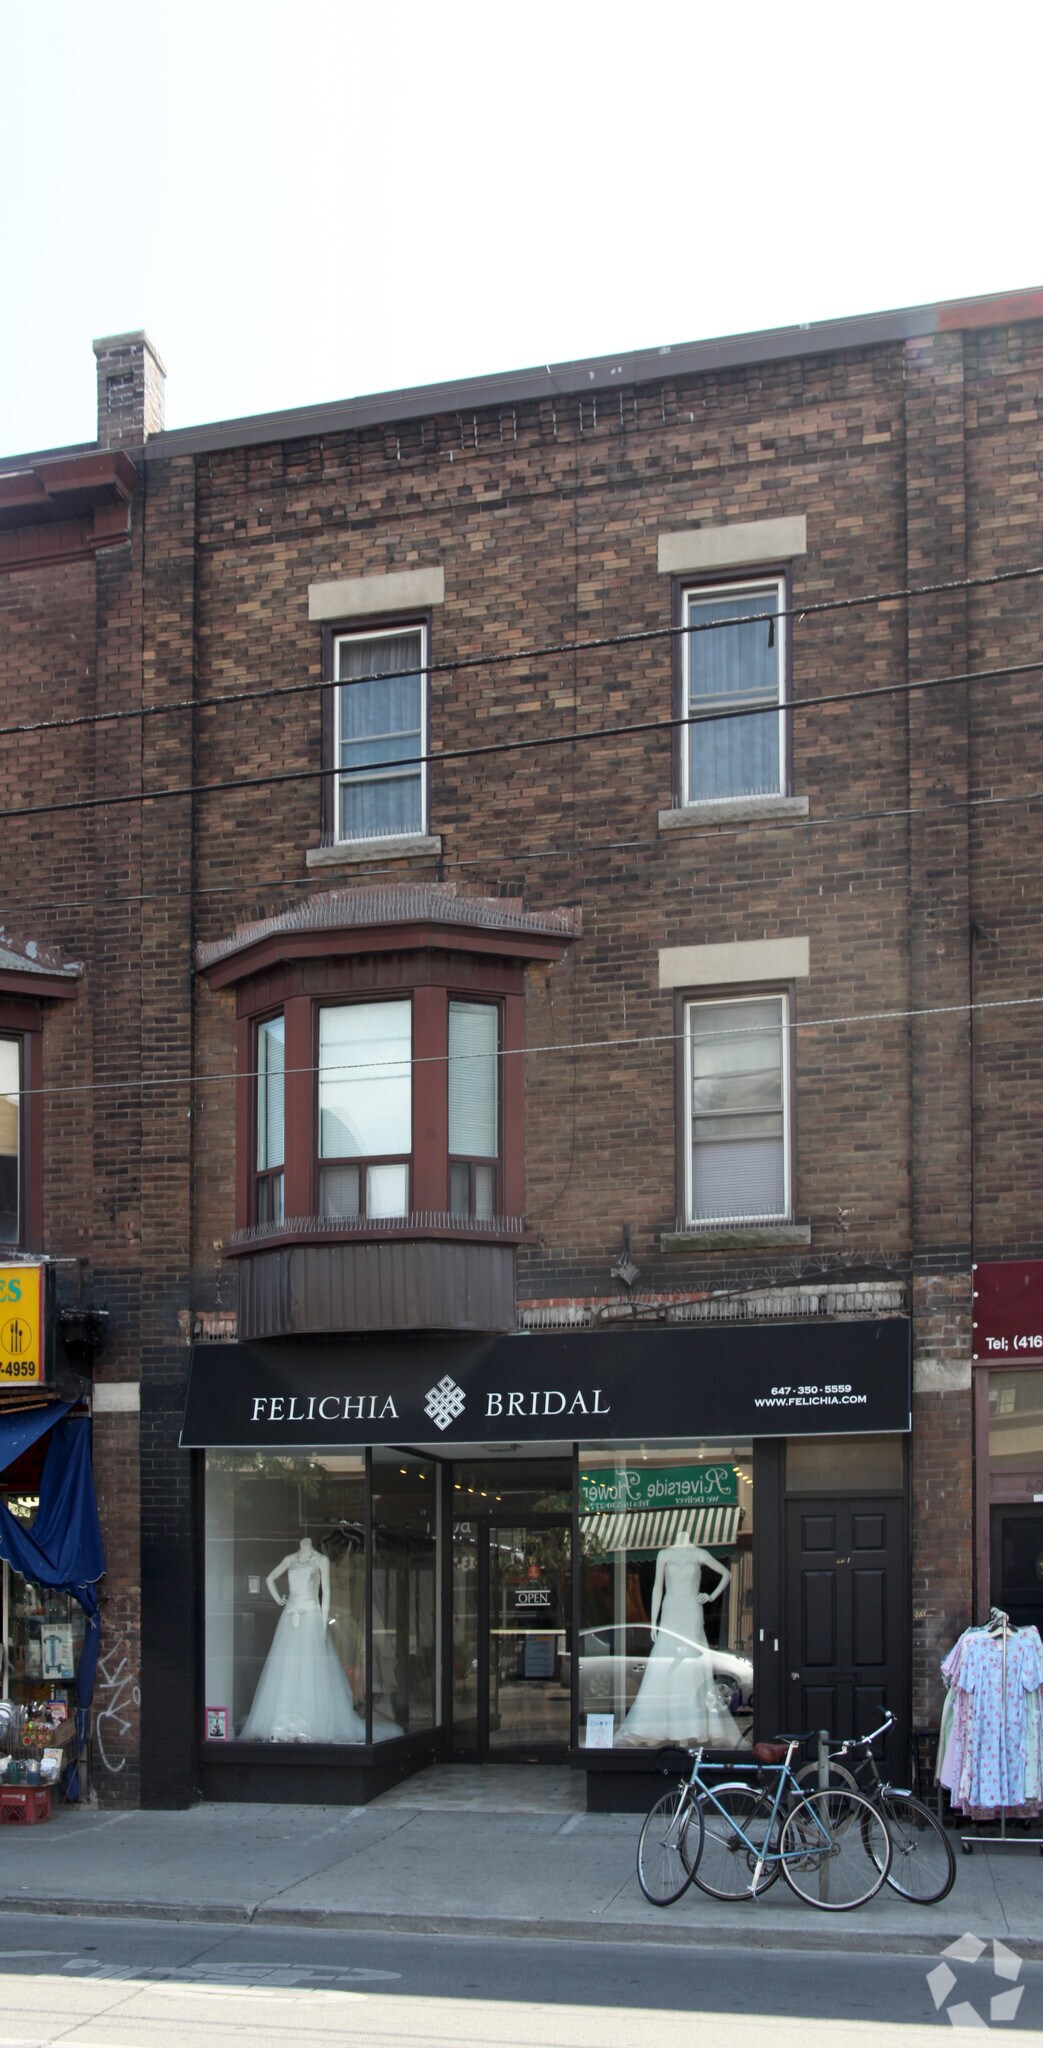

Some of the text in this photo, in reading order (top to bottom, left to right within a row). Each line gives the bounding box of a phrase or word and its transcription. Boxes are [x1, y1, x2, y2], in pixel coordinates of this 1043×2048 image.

[0, 1361, 36, 1377] -4959
[250, 1389, 611, 1422] FELICHIA BRIDAL
[754, 1395, 867, 1407] WWW.FELICHIA.COM
[518, 1593, 548, 1604] OPEN
